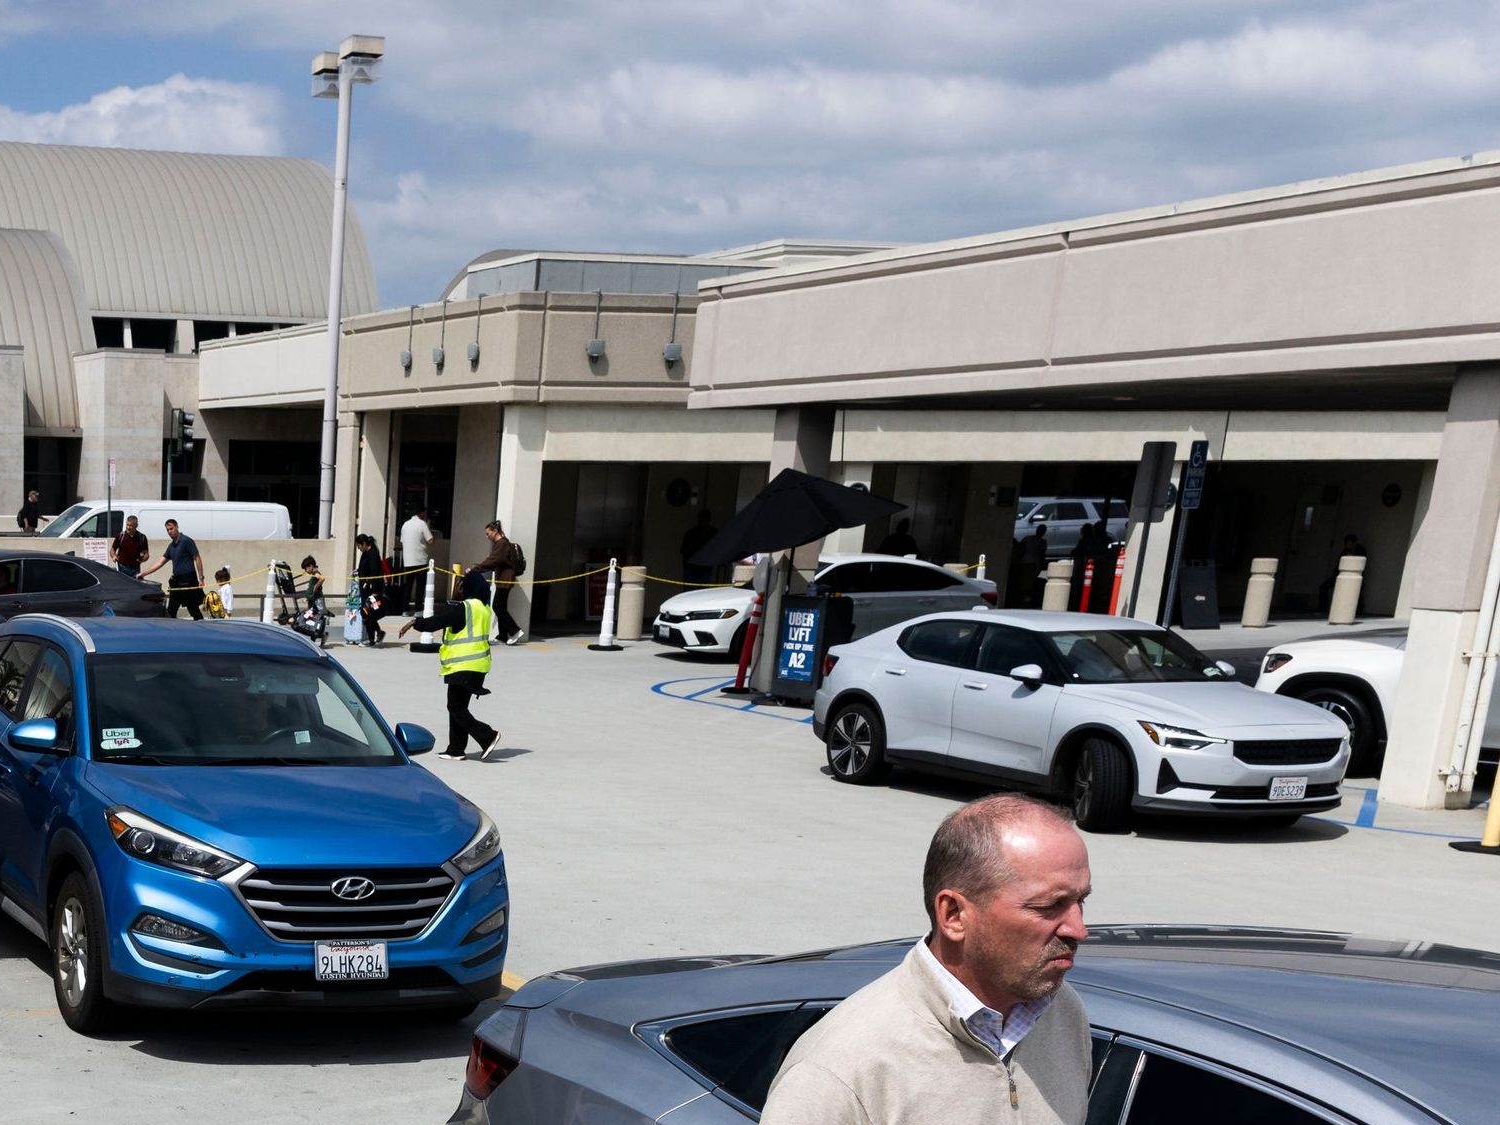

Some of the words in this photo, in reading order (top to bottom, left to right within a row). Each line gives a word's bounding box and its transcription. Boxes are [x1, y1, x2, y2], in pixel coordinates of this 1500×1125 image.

[788, 612, 814, 627] UBER
[788, 627, 811, 642] LYFT
[788, 652, 806, 668] A2
[114, 738, 130, 746] lyft
[321, 954, 383, 974] 9LHK284
